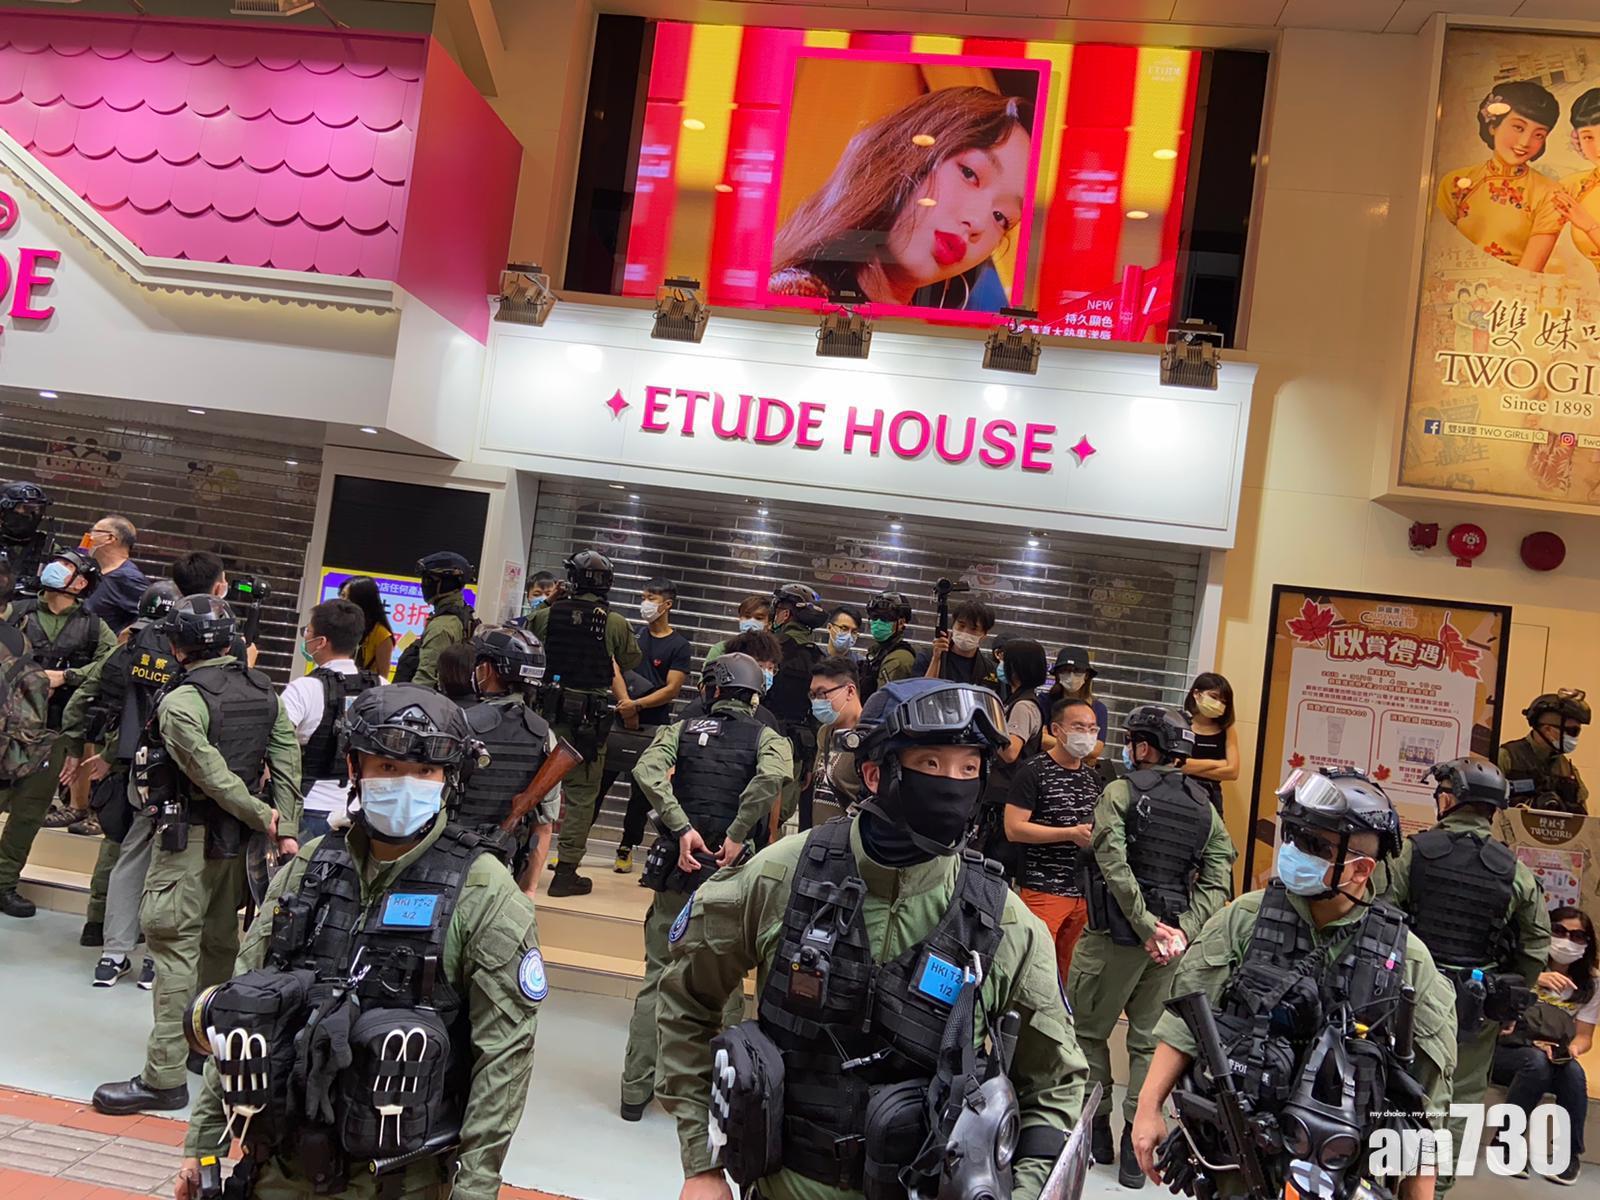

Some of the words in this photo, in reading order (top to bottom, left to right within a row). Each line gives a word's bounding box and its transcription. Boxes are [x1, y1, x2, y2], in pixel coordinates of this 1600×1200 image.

[0, 246, 62, 321] E
[1087, 300, 1114, 311] NEW
[1065, 312, 1114, 328] 持久顯色
[1438, 352, 1538, 389] TWO
[1546, 362, 1600, 397] GI
[1502, 395, 1547, 412] Since
[1555, 400, 1592, 416] 1898
[641, 385, 826, 449] ETUDE
[844, 406, 1057, 471] HOUSE
[1480, 426, 1502, 437] TWO
[376, 581, 423, 597] 店任何產
[1332, 627, 1441, 666] 秋賞禮遇
[131, 665, 171, 684] POLICE
[930, 962, 948, 979] HKI
[939, 984, 953, 998] 1/2
